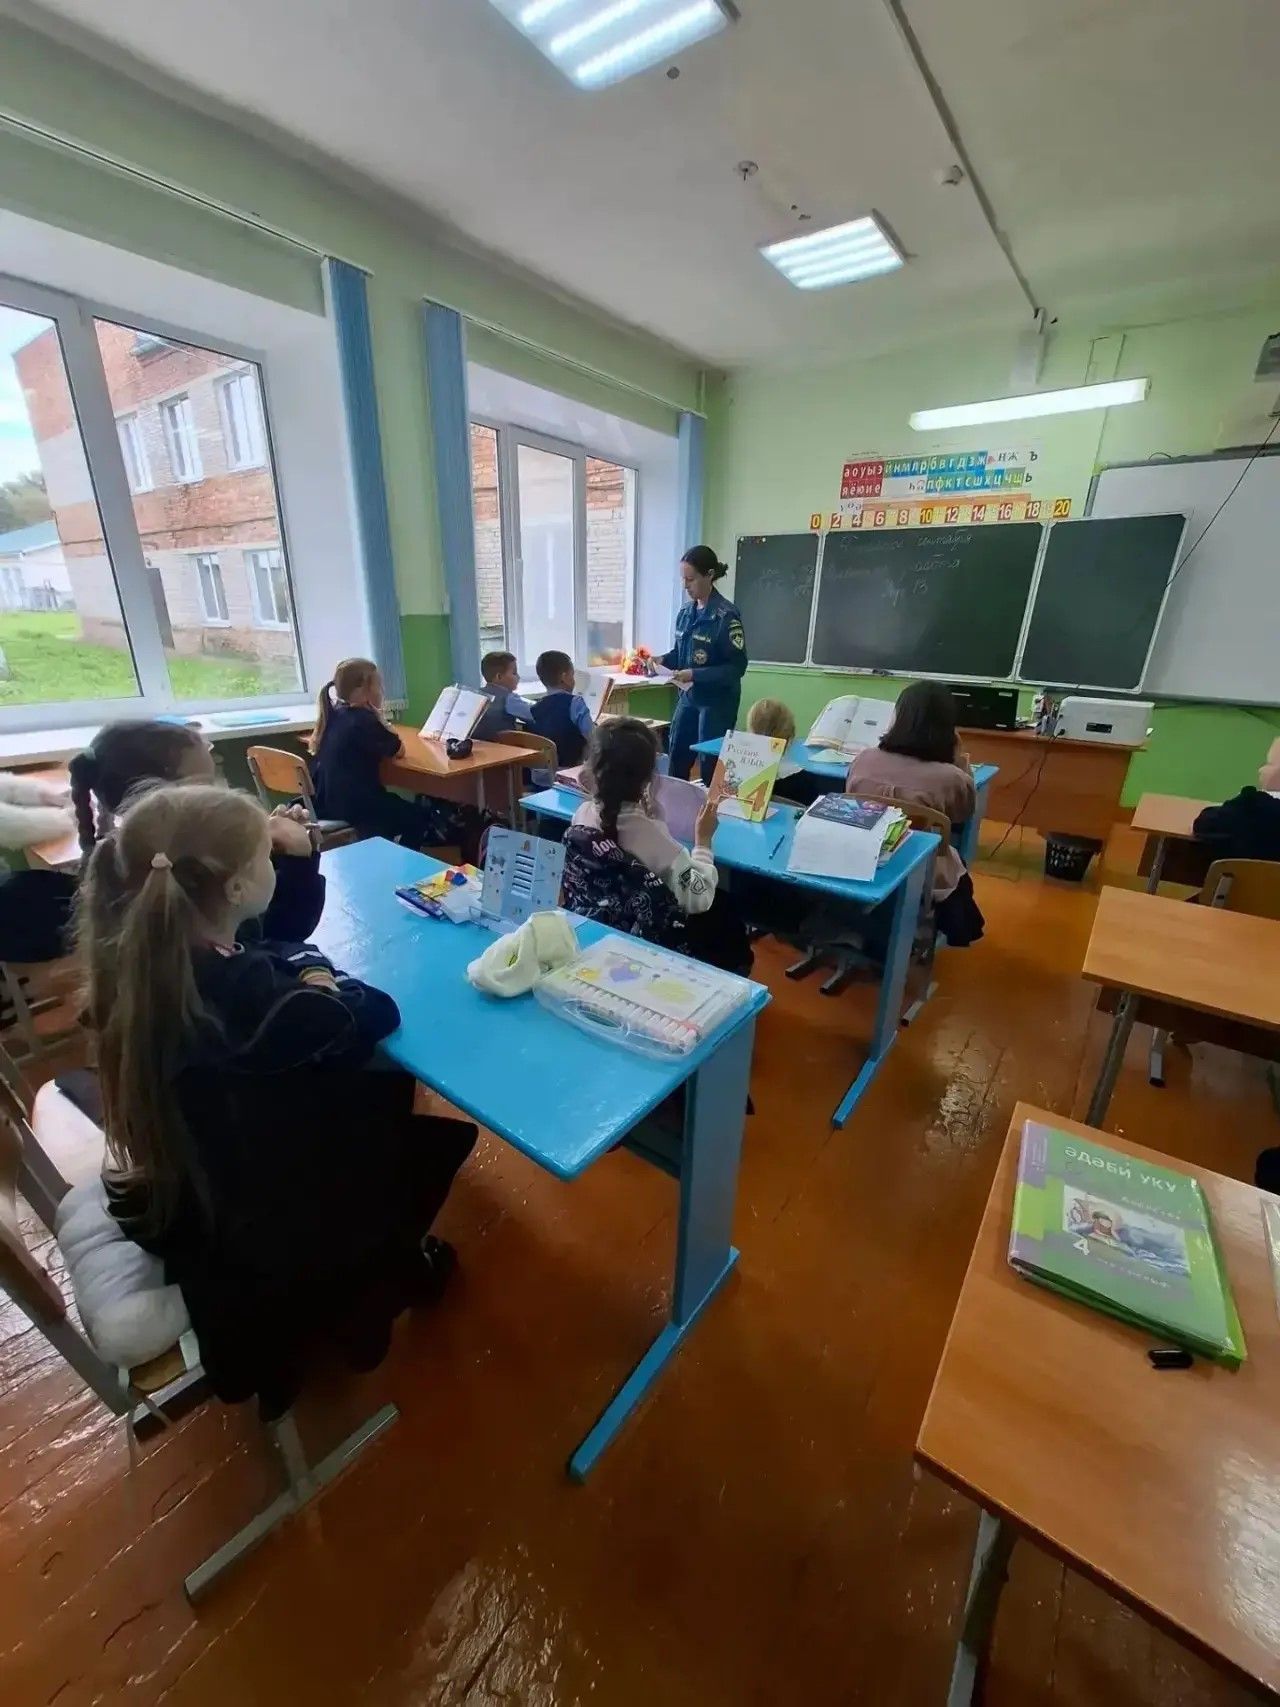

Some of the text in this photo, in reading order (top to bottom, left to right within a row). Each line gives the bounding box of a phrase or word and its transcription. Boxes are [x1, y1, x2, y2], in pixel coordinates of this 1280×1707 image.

[831, 514, 841, 527] 2
[852, 514, 861, 526] 4
[875, 511, 885, 525] 6
[899, 509, 909, 524] 8
[920, 508, 933, 523] 10
[946, 507, 958, 522] 12
[972, 506, 985, 520] 14
[999, 503, 1012, 519] 16
[1026, 501, 1041, 517] 18
[1053, 500, 1070, 517] 20
[1072, 1238, 1090, 1256] 4
